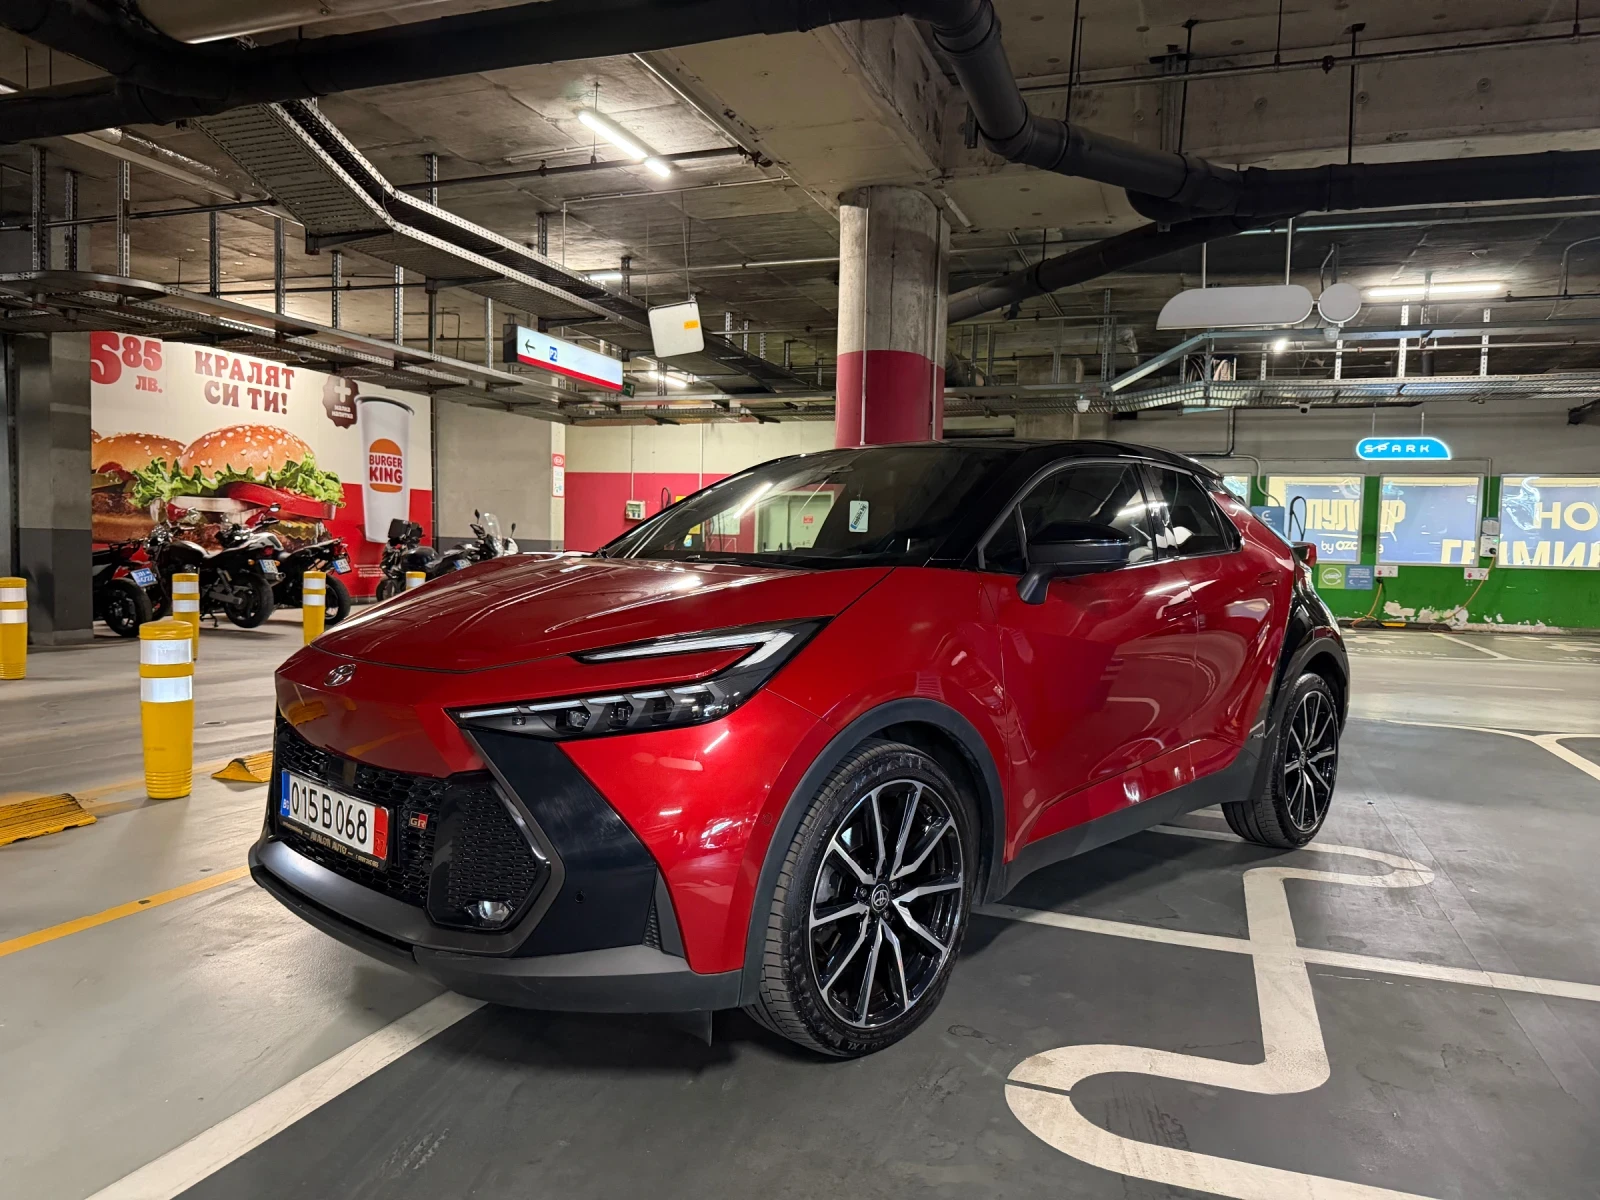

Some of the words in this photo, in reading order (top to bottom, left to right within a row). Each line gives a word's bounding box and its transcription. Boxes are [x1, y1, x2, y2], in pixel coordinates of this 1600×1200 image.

[194, 350, 295, 390] КРАЛЯТ
[204, 380, 239, 408] СИ
[247, 387, 288, 415] ТИ!
[1364, 442, 1430, 454] SPARK
[369, 454, 403, 469] BURGER
[369, 466, 403, 484] KING
[1321, 541, 1334, 554] by
[410, 817, 426, 828] GR
